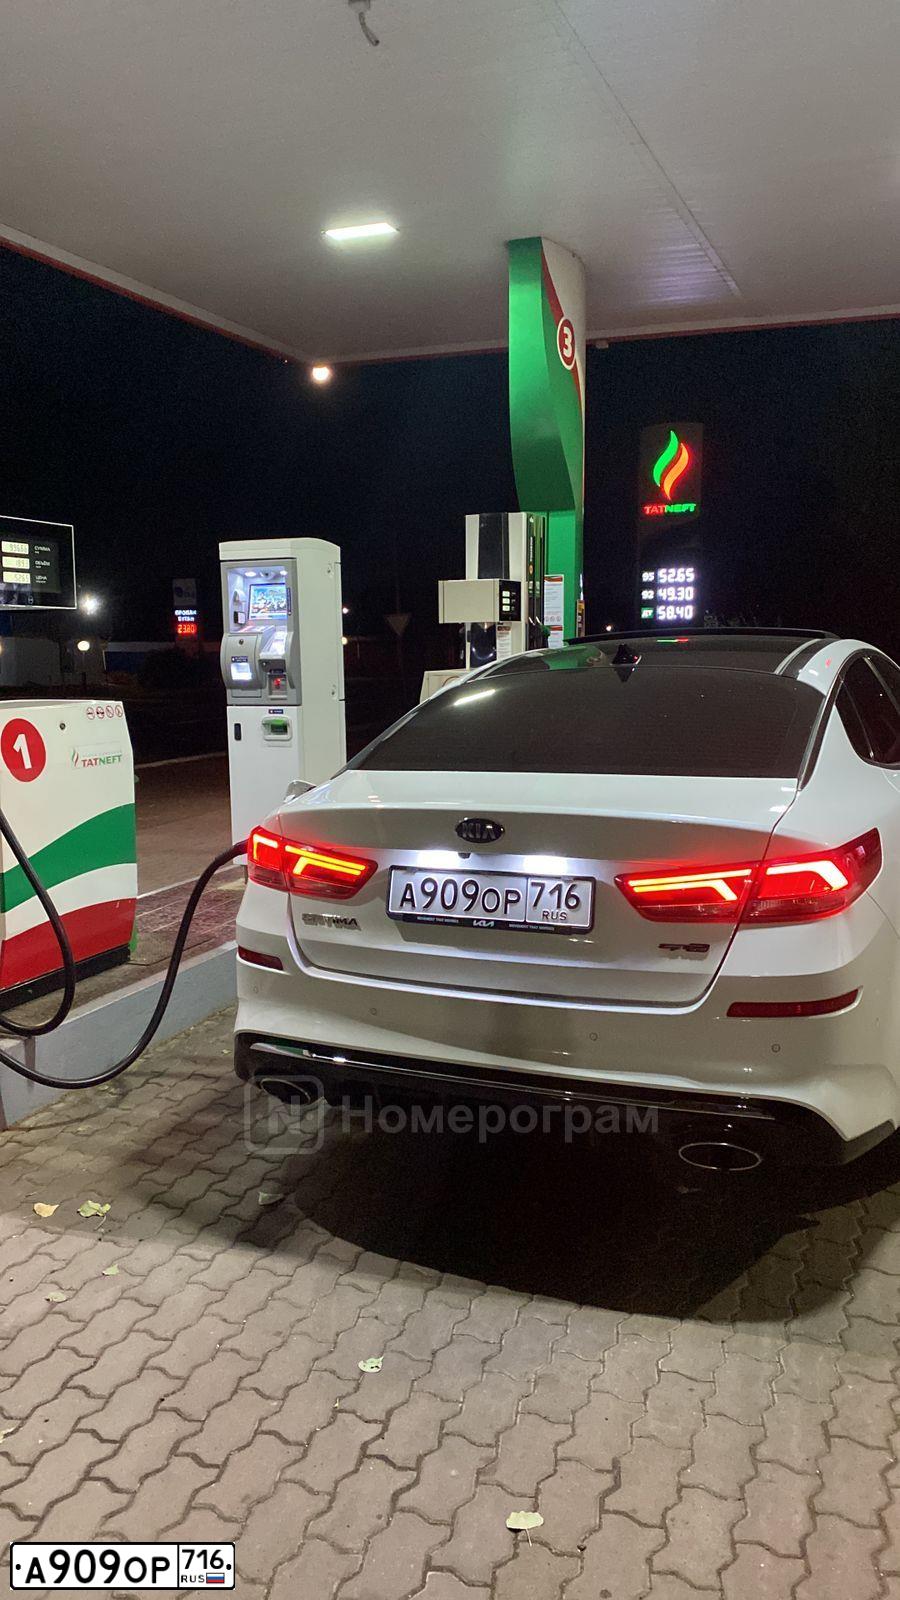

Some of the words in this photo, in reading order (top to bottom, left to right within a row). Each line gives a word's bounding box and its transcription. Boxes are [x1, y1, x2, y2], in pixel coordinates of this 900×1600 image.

[563, 326, 573, 358] 3
[643, 503, 696, 514] TATNEFT
[641, 572, 655, 582] 95
[657, 568, 695, 583] 52.65
[641, 590, 655, 600] 92
[657, 586, 694, 601] 49.30
[657, 604, 694, 620] 58.40
[13, 733, 33, 770] 1
[81, 754, 123, 768] TATNEFT
[462, 822, 496, 840] KIA
[531, 881, 581, 910] 716
[542, 910, 568, 921] RUS
